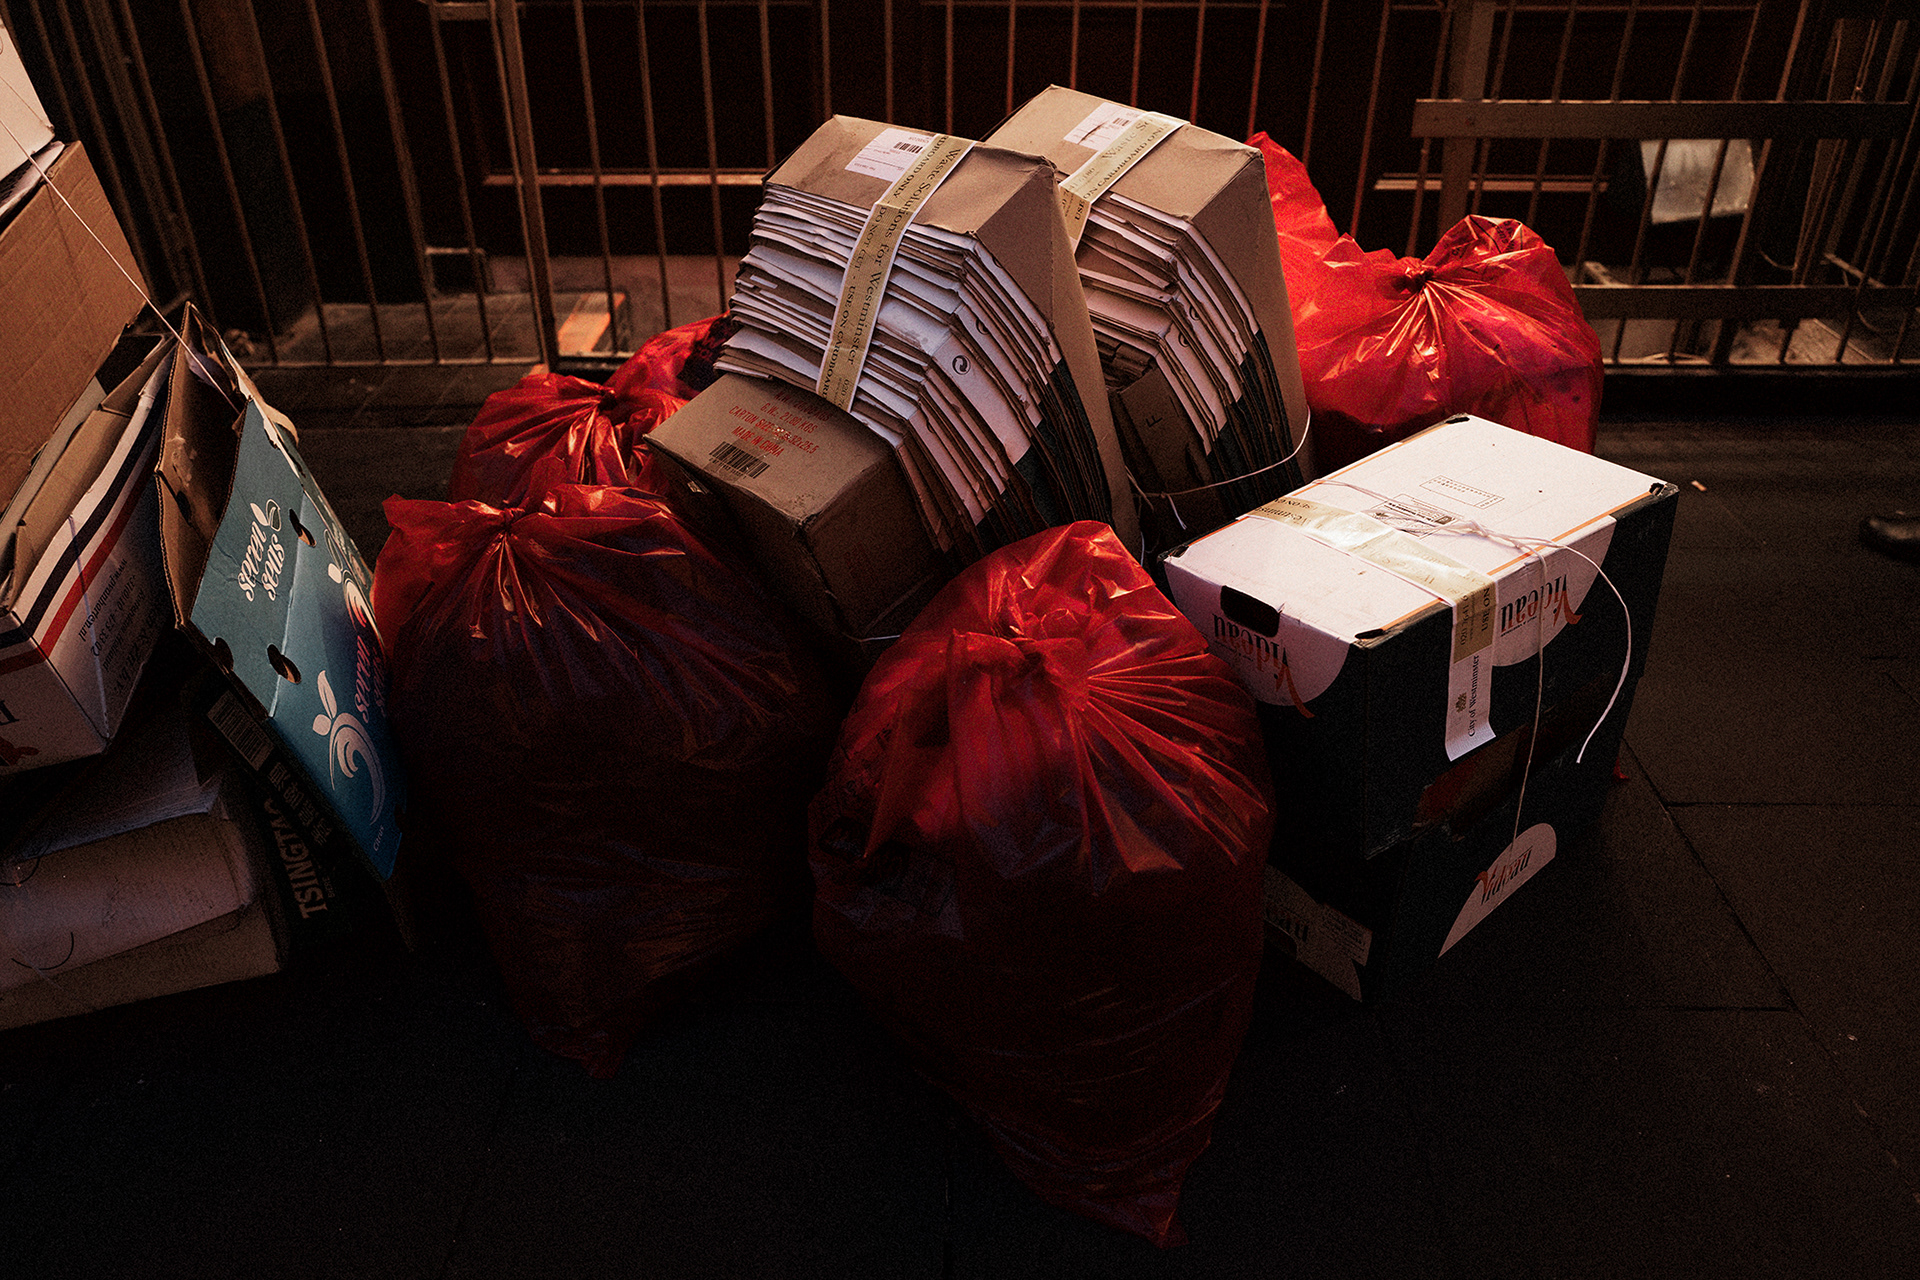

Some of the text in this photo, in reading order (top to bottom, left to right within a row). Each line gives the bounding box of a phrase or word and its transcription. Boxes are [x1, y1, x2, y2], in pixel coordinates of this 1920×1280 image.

[927, 149, 960, 180] Waste
[893, 173, 914, 198] ONLY
[1074, 199, 1085, 220] USE
[1083, 185, 1097, 199] ON
[1097, 141, 1147, 186] CARDBOARD
[874, 207, 886, 222] DO
[884, 182, 929, 239] Solutions
[862, 225, 876, 247] NOT
[854, 249, 865, 270] CUT
[873, 243, 889, 266] for
[844, 287, 855, 308] USE
[839, 310, 848, 327] ON
[847, 272, 882, 364] Westminster
[728, 406, 759, 424] CARTON
[798, 420, 817, 433] KGS
[760, 438, 785, 457] CHINA
[237, 521, 266, 602] seven
[261, 532, 286, 602] seas
[77, 559, 128, 641] www.pvanharten.nl
[1481, 587, 1489, 630] USE ON
[102, 632, 124, 671] Holland
[1212, 612, 1316, 718] Videau
[354, 635, 371, 724] seven
[1468, 655, 1478, 736] City of Westminster
[373, 825, 386, 853] Citrus
